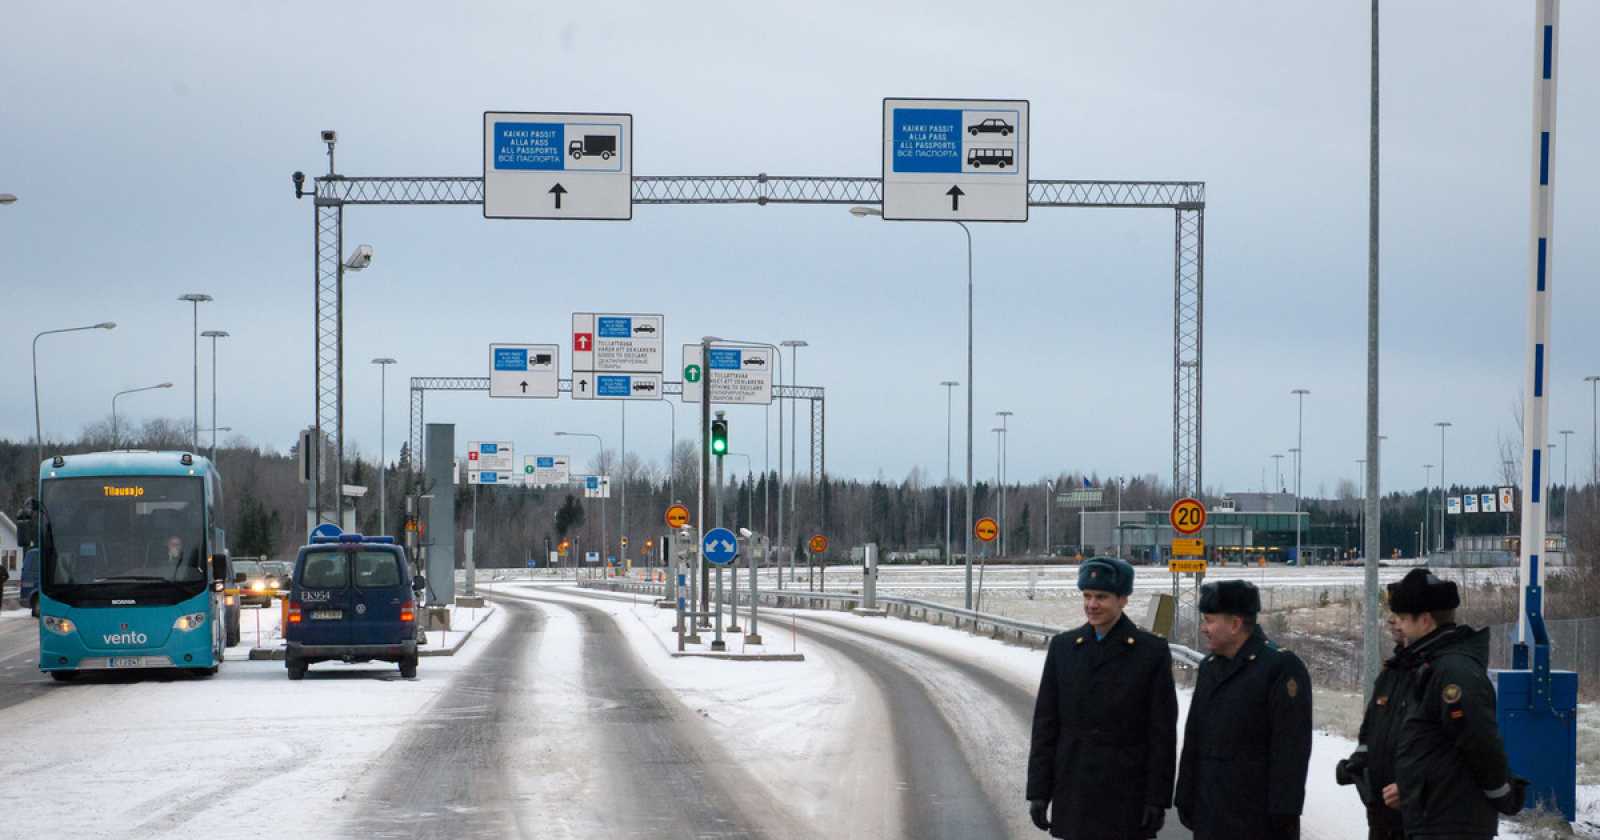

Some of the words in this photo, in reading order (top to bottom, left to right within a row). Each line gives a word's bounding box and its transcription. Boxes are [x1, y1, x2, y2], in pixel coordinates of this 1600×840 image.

[104, 486, 144, 497] Tilausajo
[1178, 507, 1200, 525] 20
[300, 591, 330, 600] EK954
[103, 631, 147, 645] vento
